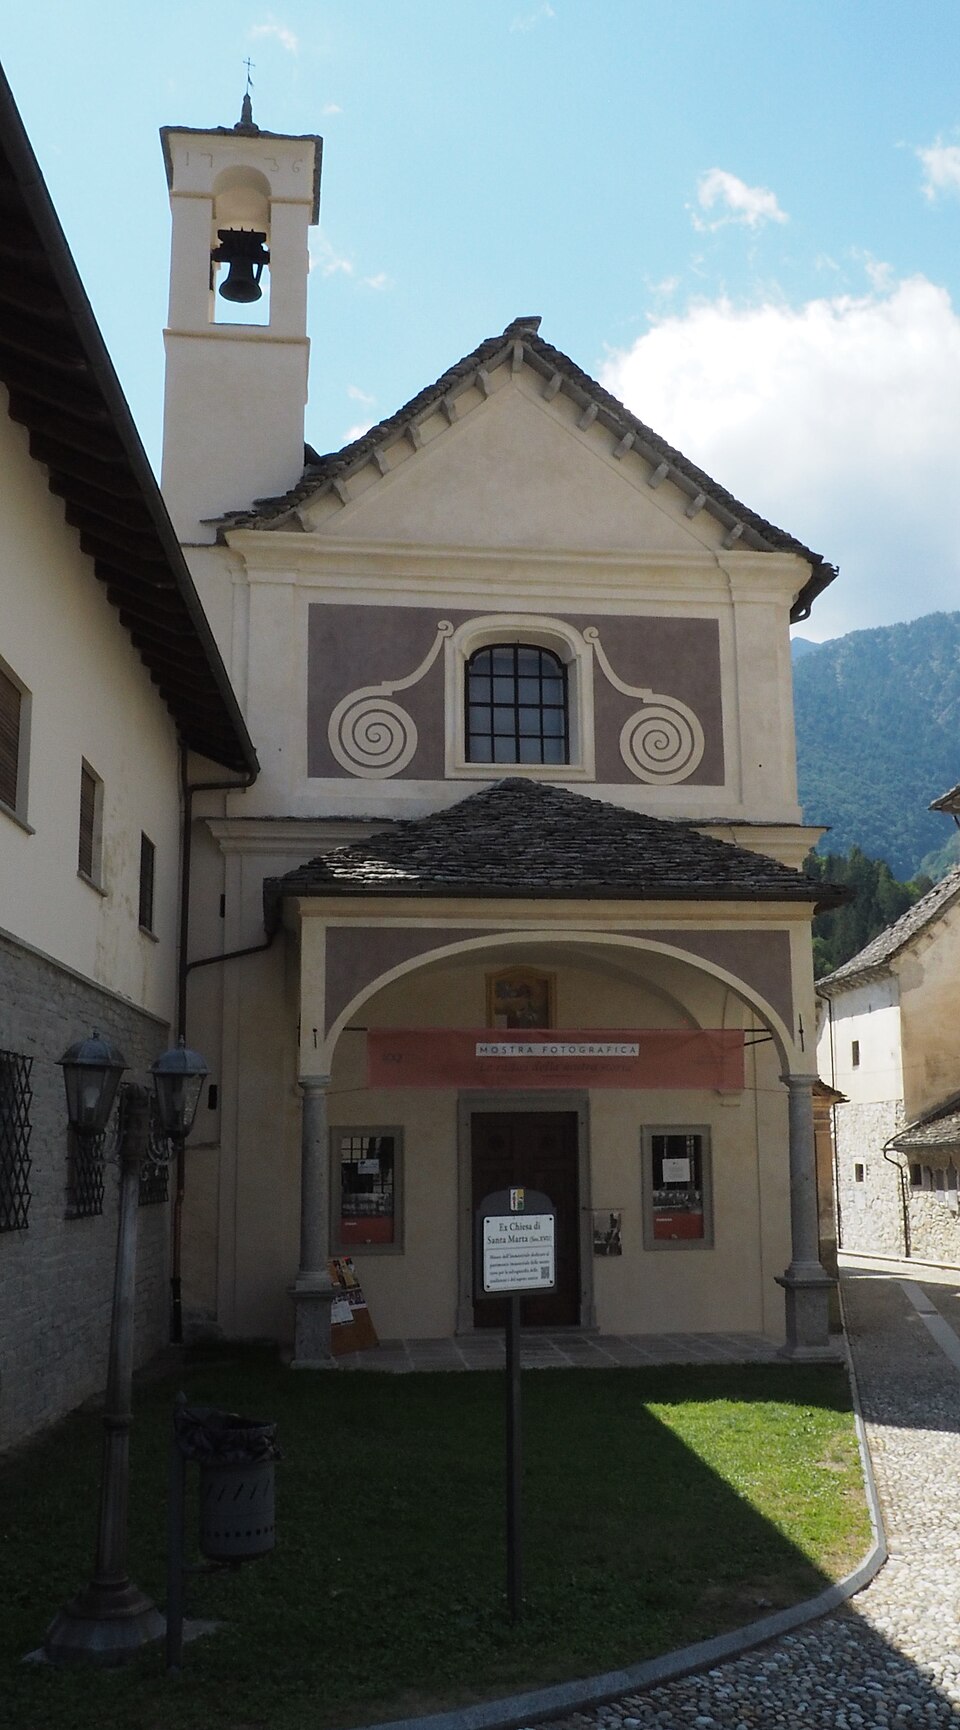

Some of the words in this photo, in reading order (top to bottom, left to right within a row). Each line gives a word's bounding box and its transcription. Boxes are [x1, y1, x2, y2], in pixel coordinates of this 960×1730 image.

[480, 1046, 533, 1054] MOSTRA
[542, 1046, 636, 1054] FOTOGRAFICA
[499, 1223, 508, 1232] Ex
[509, 1221, 532, 1231] Chiesa
[533, 1221, 541, 1230] di
[487, 1235, 506, 1244] Santa
[508, 1235, 528, 1243] Marta
